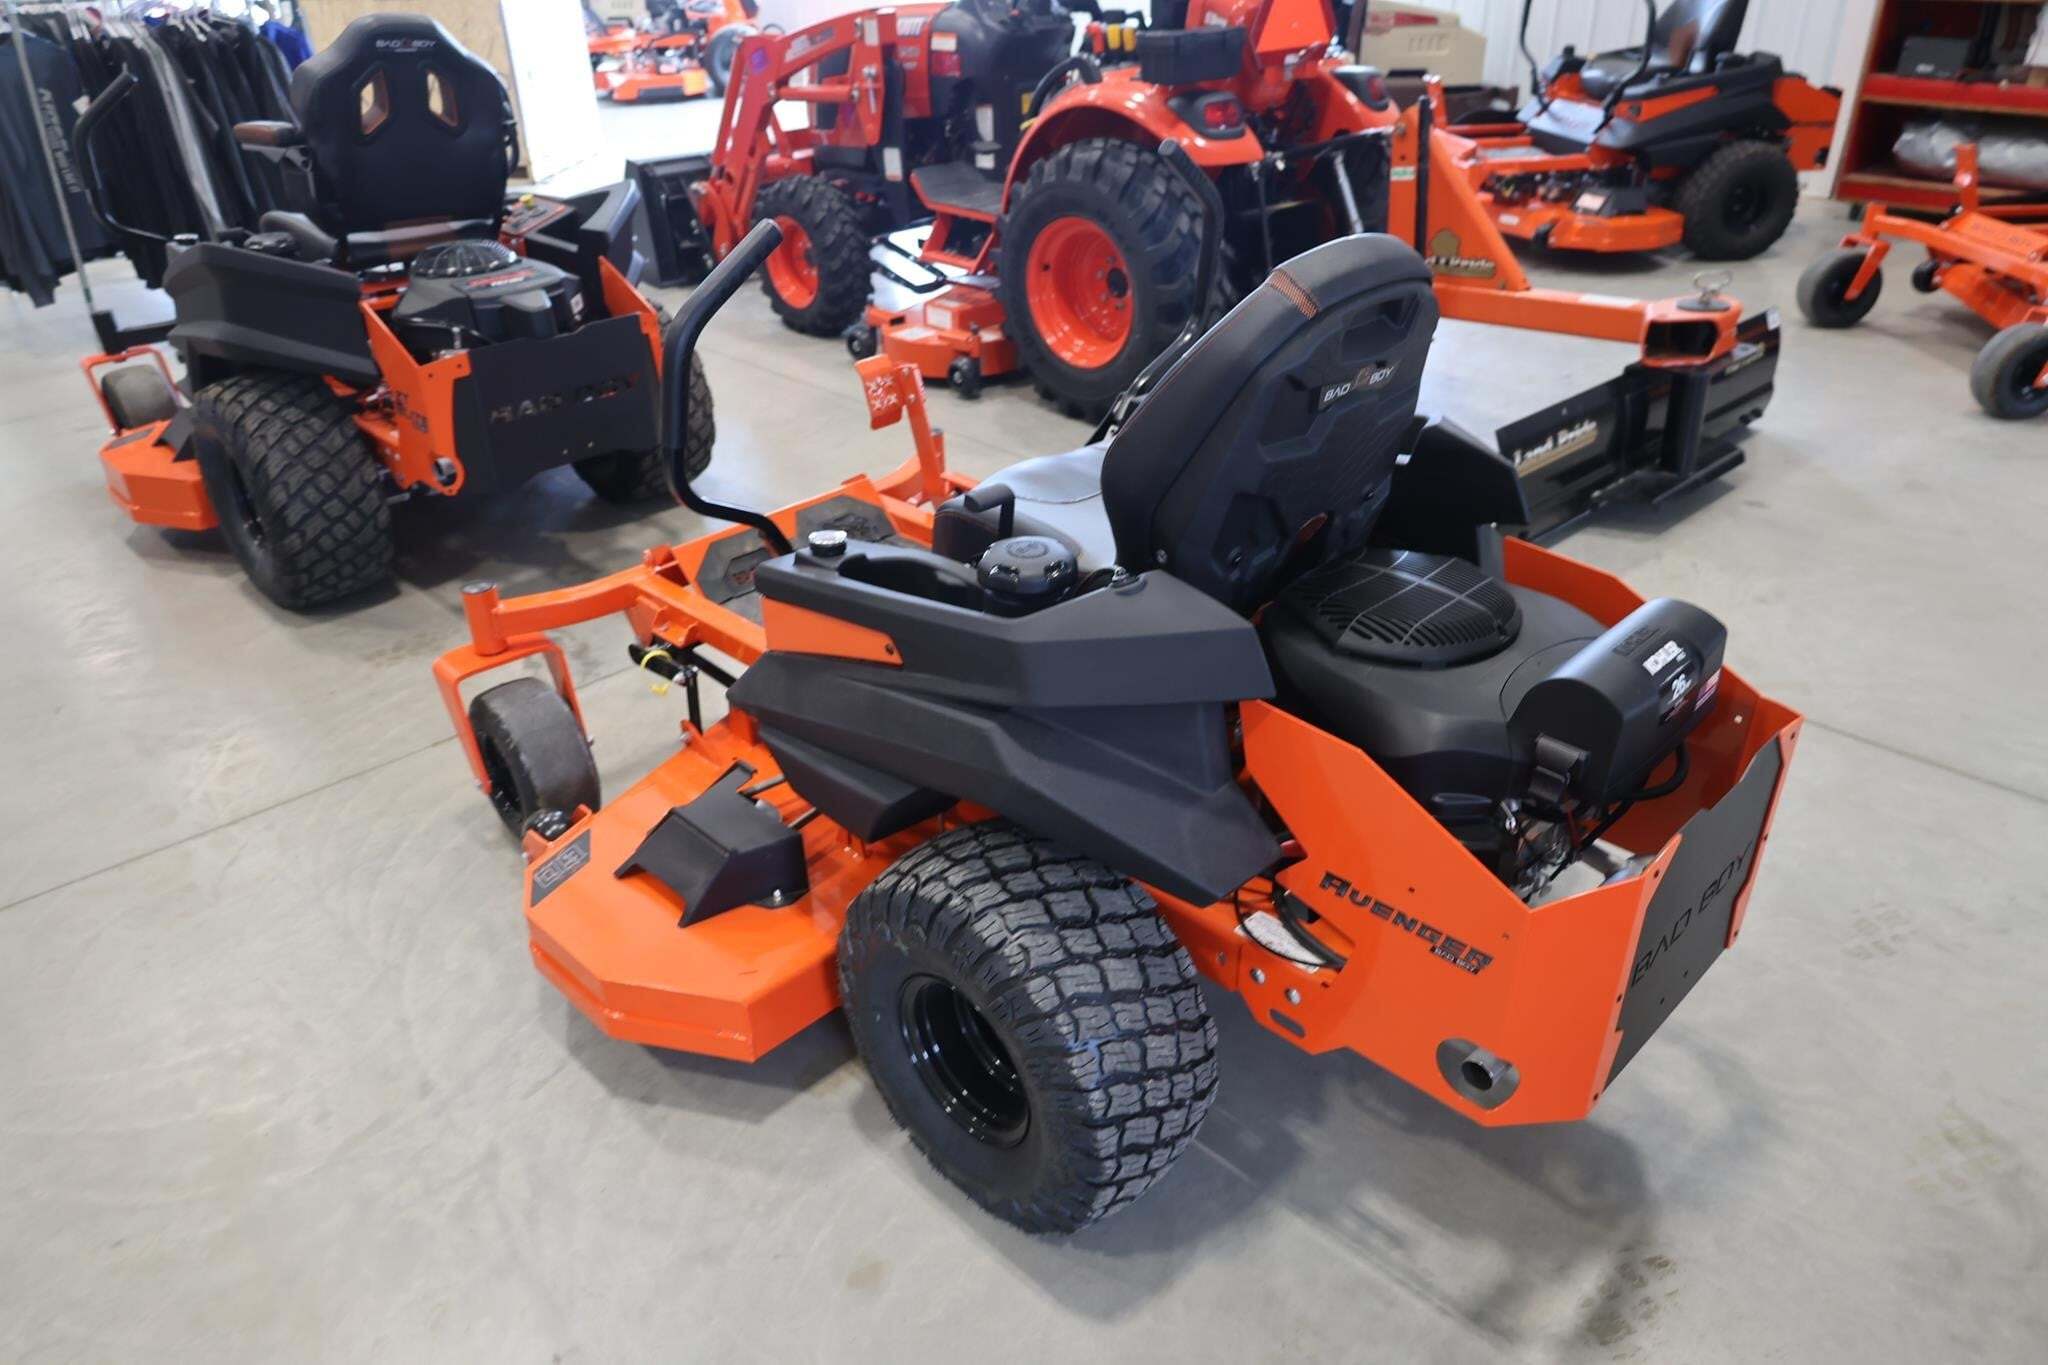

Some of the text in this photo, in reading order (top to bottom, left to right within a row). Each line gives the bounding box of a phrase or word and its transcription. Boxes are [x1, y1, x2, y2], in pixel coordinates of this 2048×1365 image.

[1323, 366, 1394, 402] BAD BOY
[1319, 870, 1494, 967] AVENGER
[1631, 841, 1752, 987] BAD BOY
